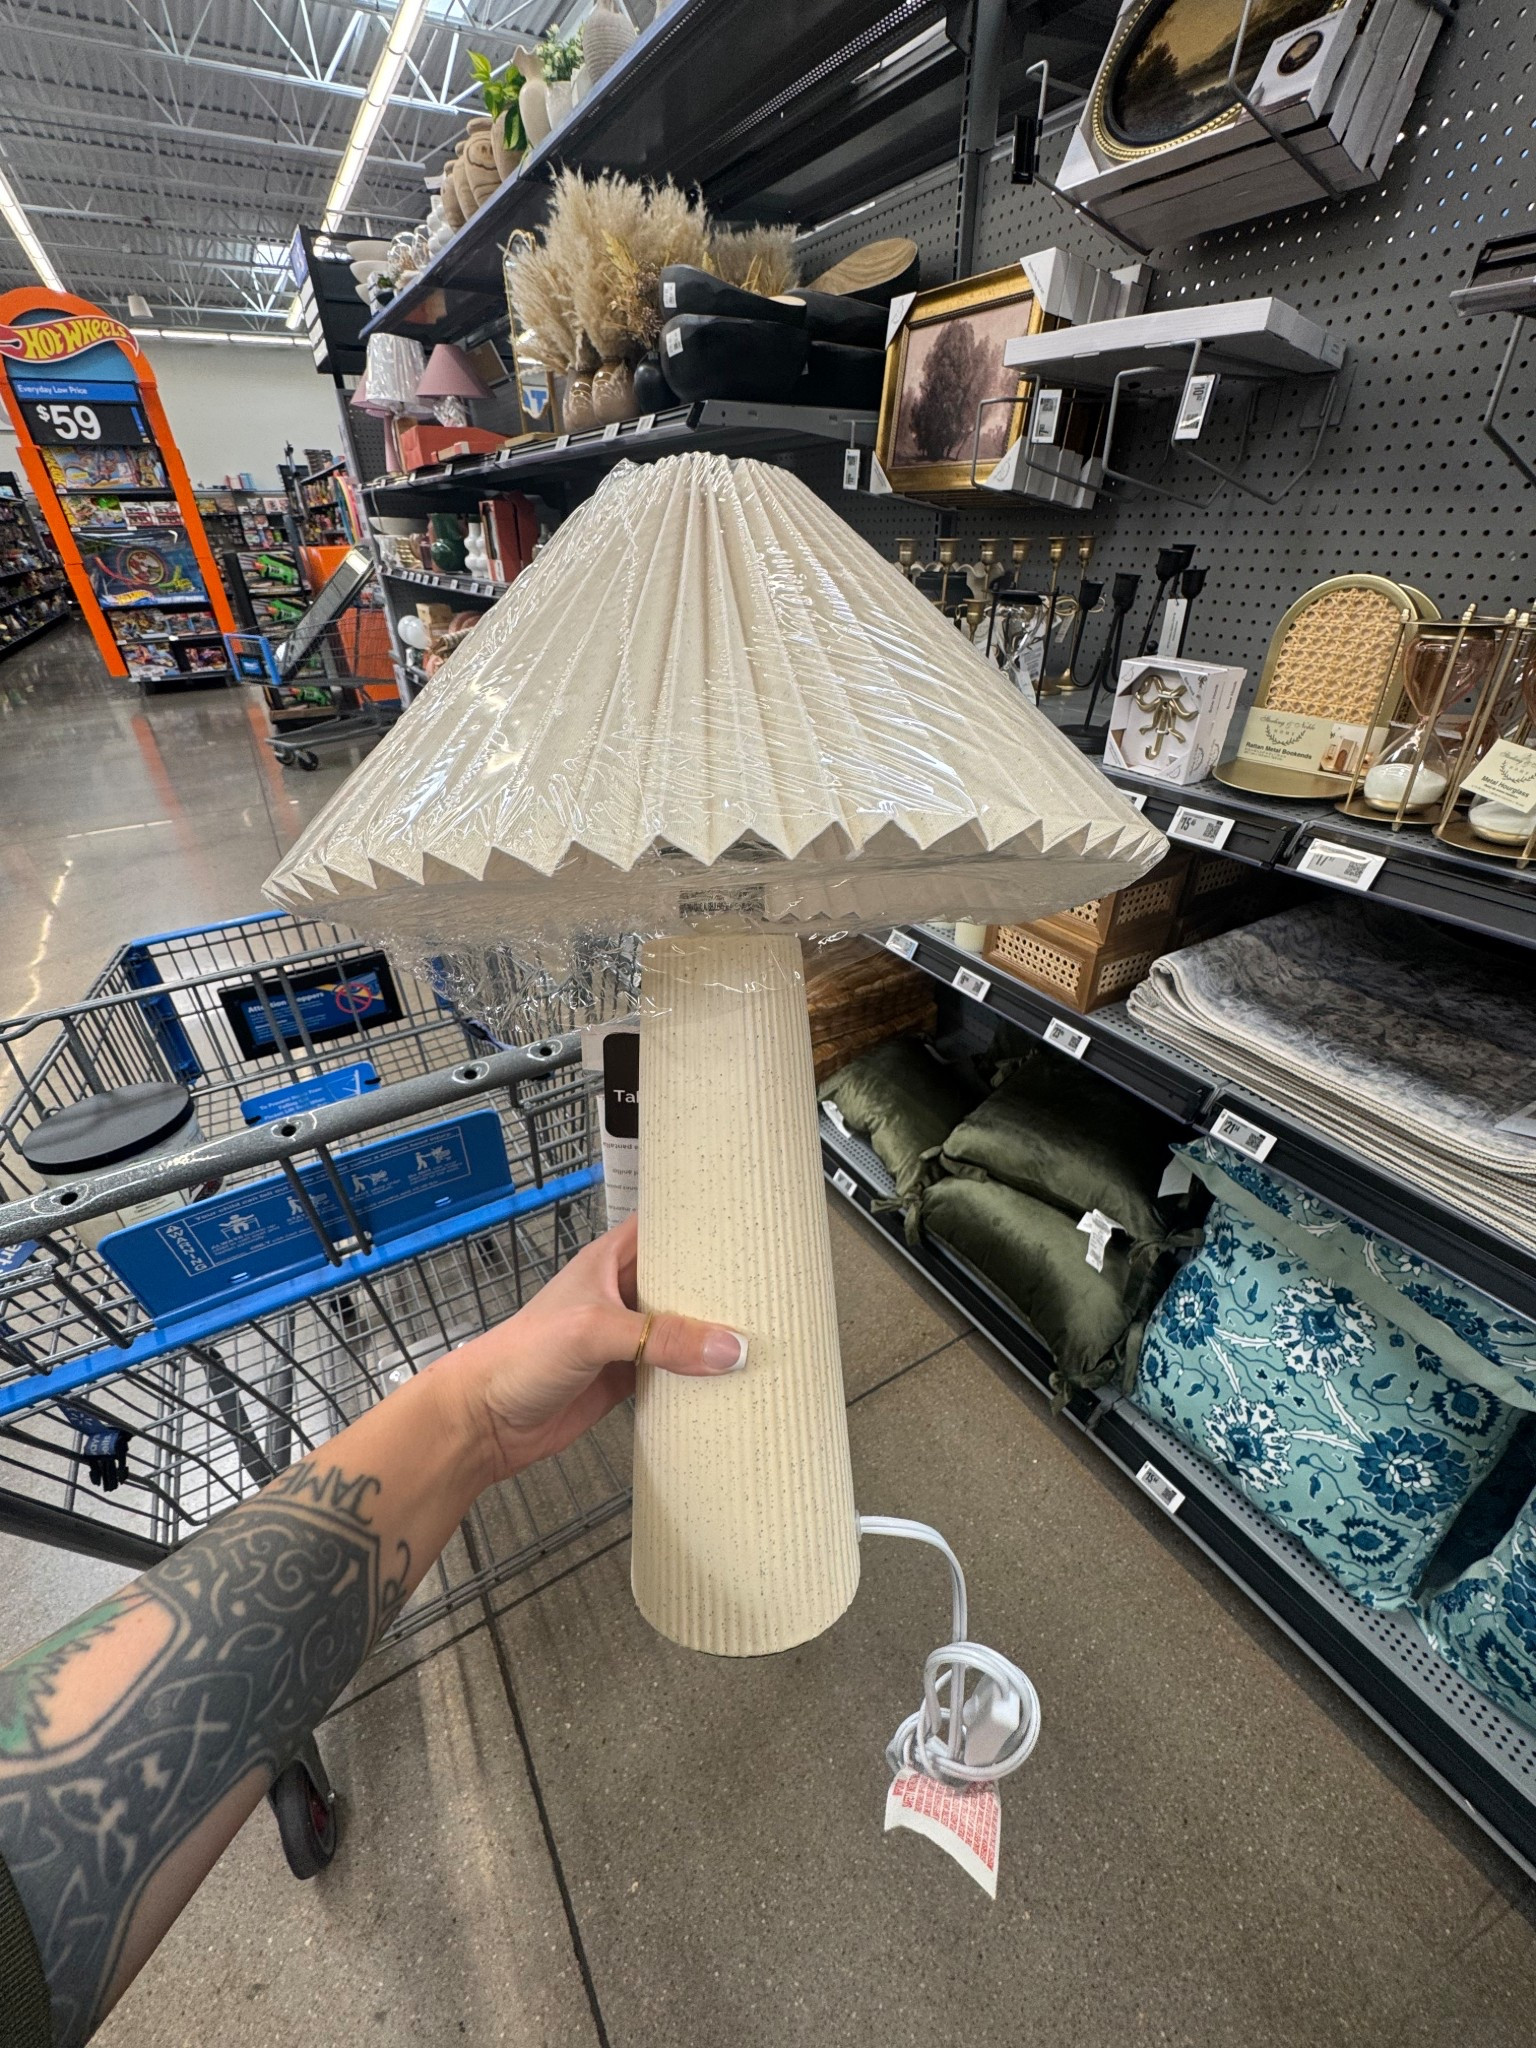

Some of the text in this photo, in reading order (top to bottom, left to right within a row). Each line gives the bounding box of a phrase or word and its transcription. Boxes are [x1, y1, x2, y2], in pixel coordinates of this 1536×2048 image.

[17, 384, 88, 395] Everyday Low Price
[35, 403, 101, 440] $59
[1246, 742, 1264, 750] Rattan
[1265, 745, 1281, 753] Metal
[1282, 748, 1312, 760] Bookends
[1481, 775, 1499, 786] Metal
[1498, 782, 1530, 798] Hourglass
[248, 1000, 287, 1014] Attetion
[613, 1089, 639, 1104] Ta
[167, 1229, 208, 1272] WARNING
